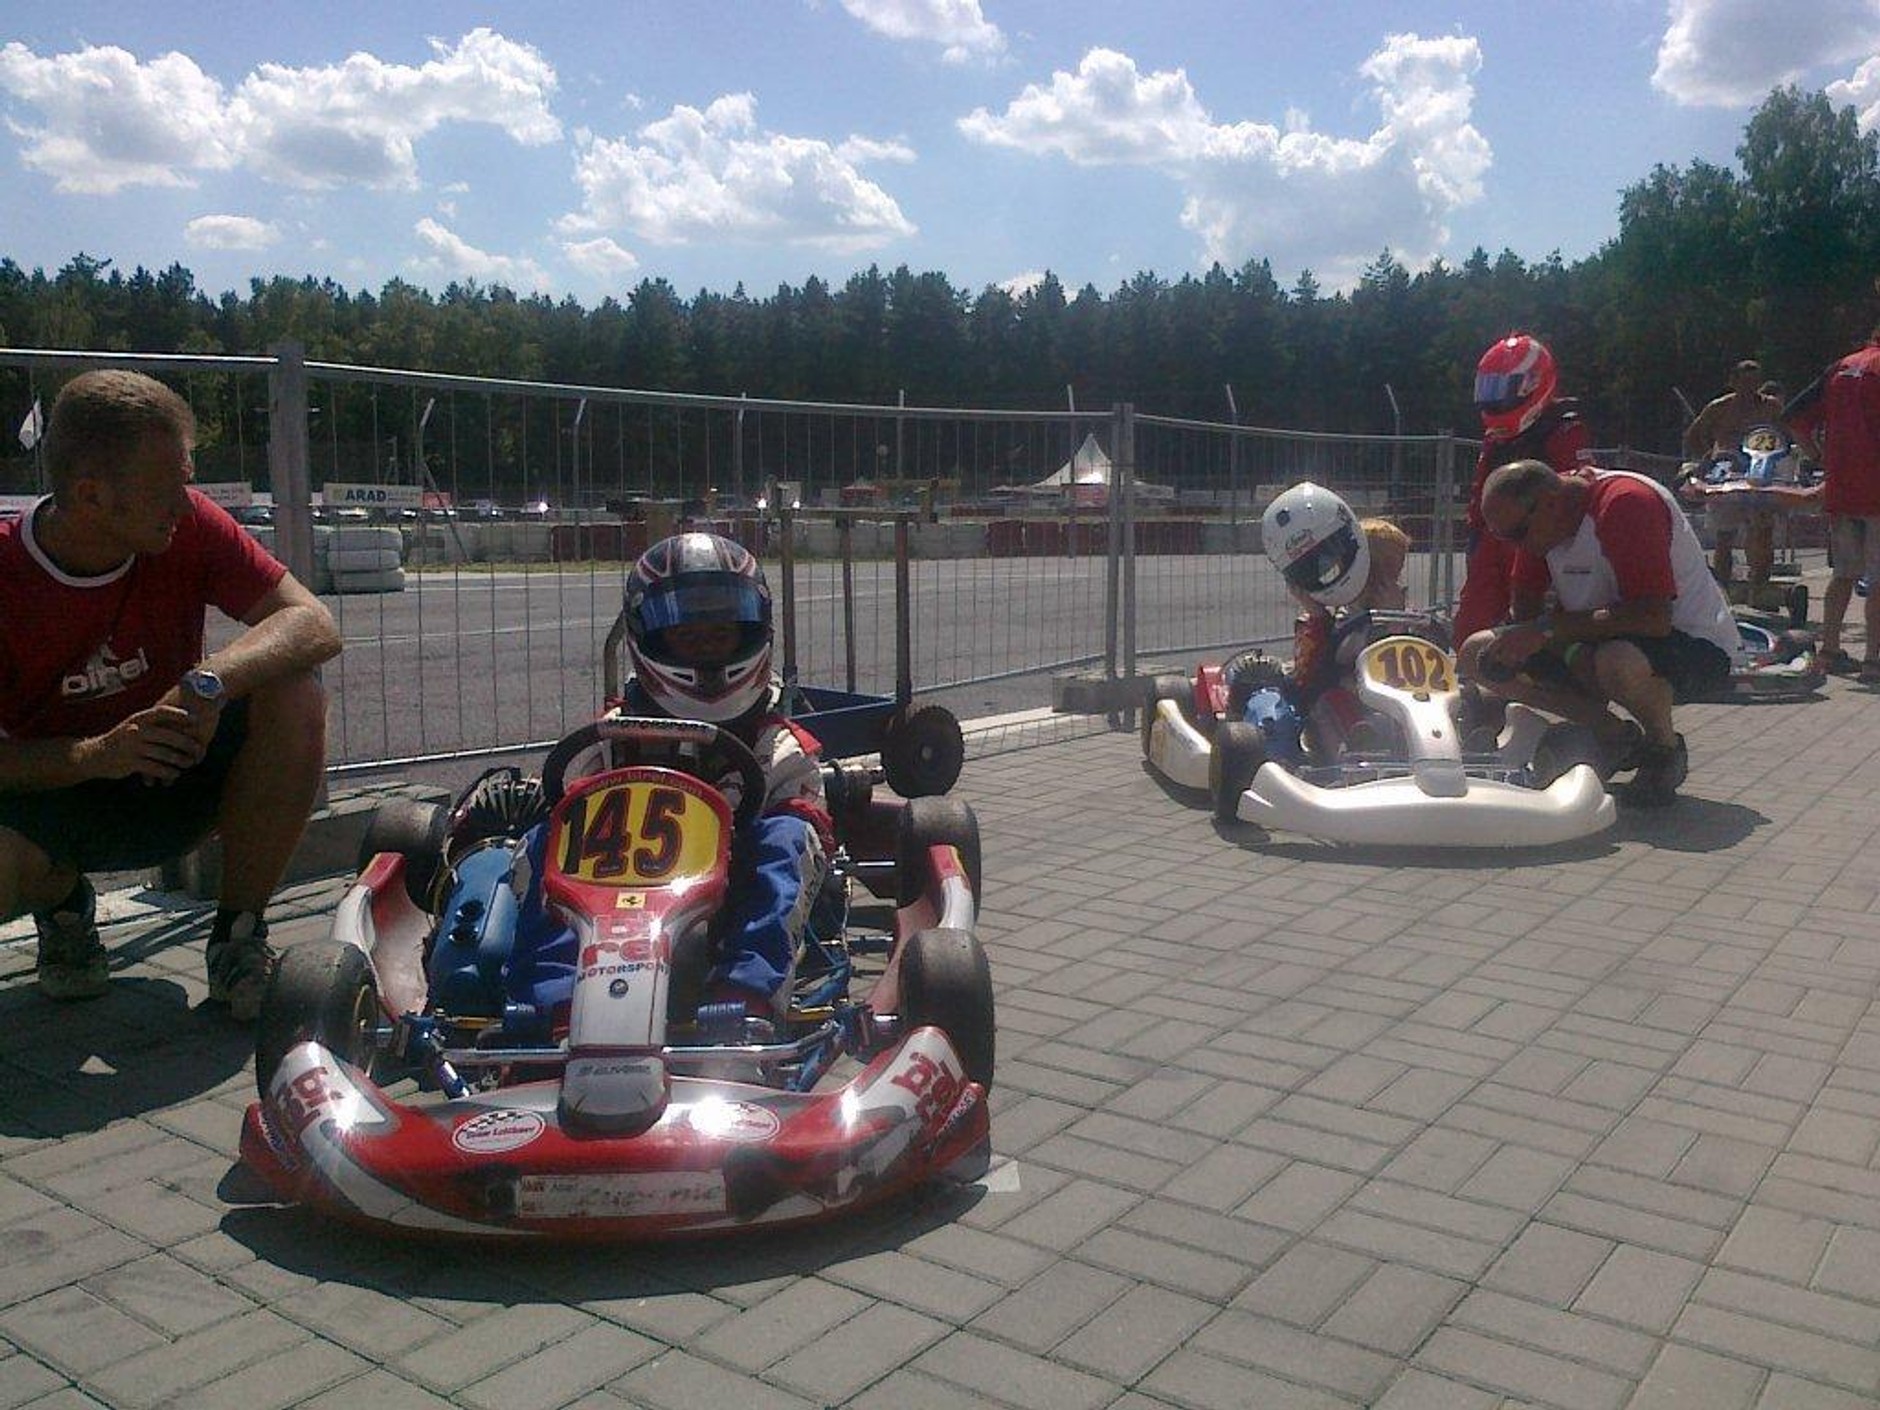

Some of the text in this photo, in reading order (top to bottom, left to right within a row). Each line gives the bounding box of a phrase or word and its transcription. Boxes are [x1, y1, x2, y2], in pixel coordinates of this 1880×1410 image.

[345, 489, 387, 503] ARAD
[1377, 645, 1450, 692] 102
[560, 787, 686, 879] 145
